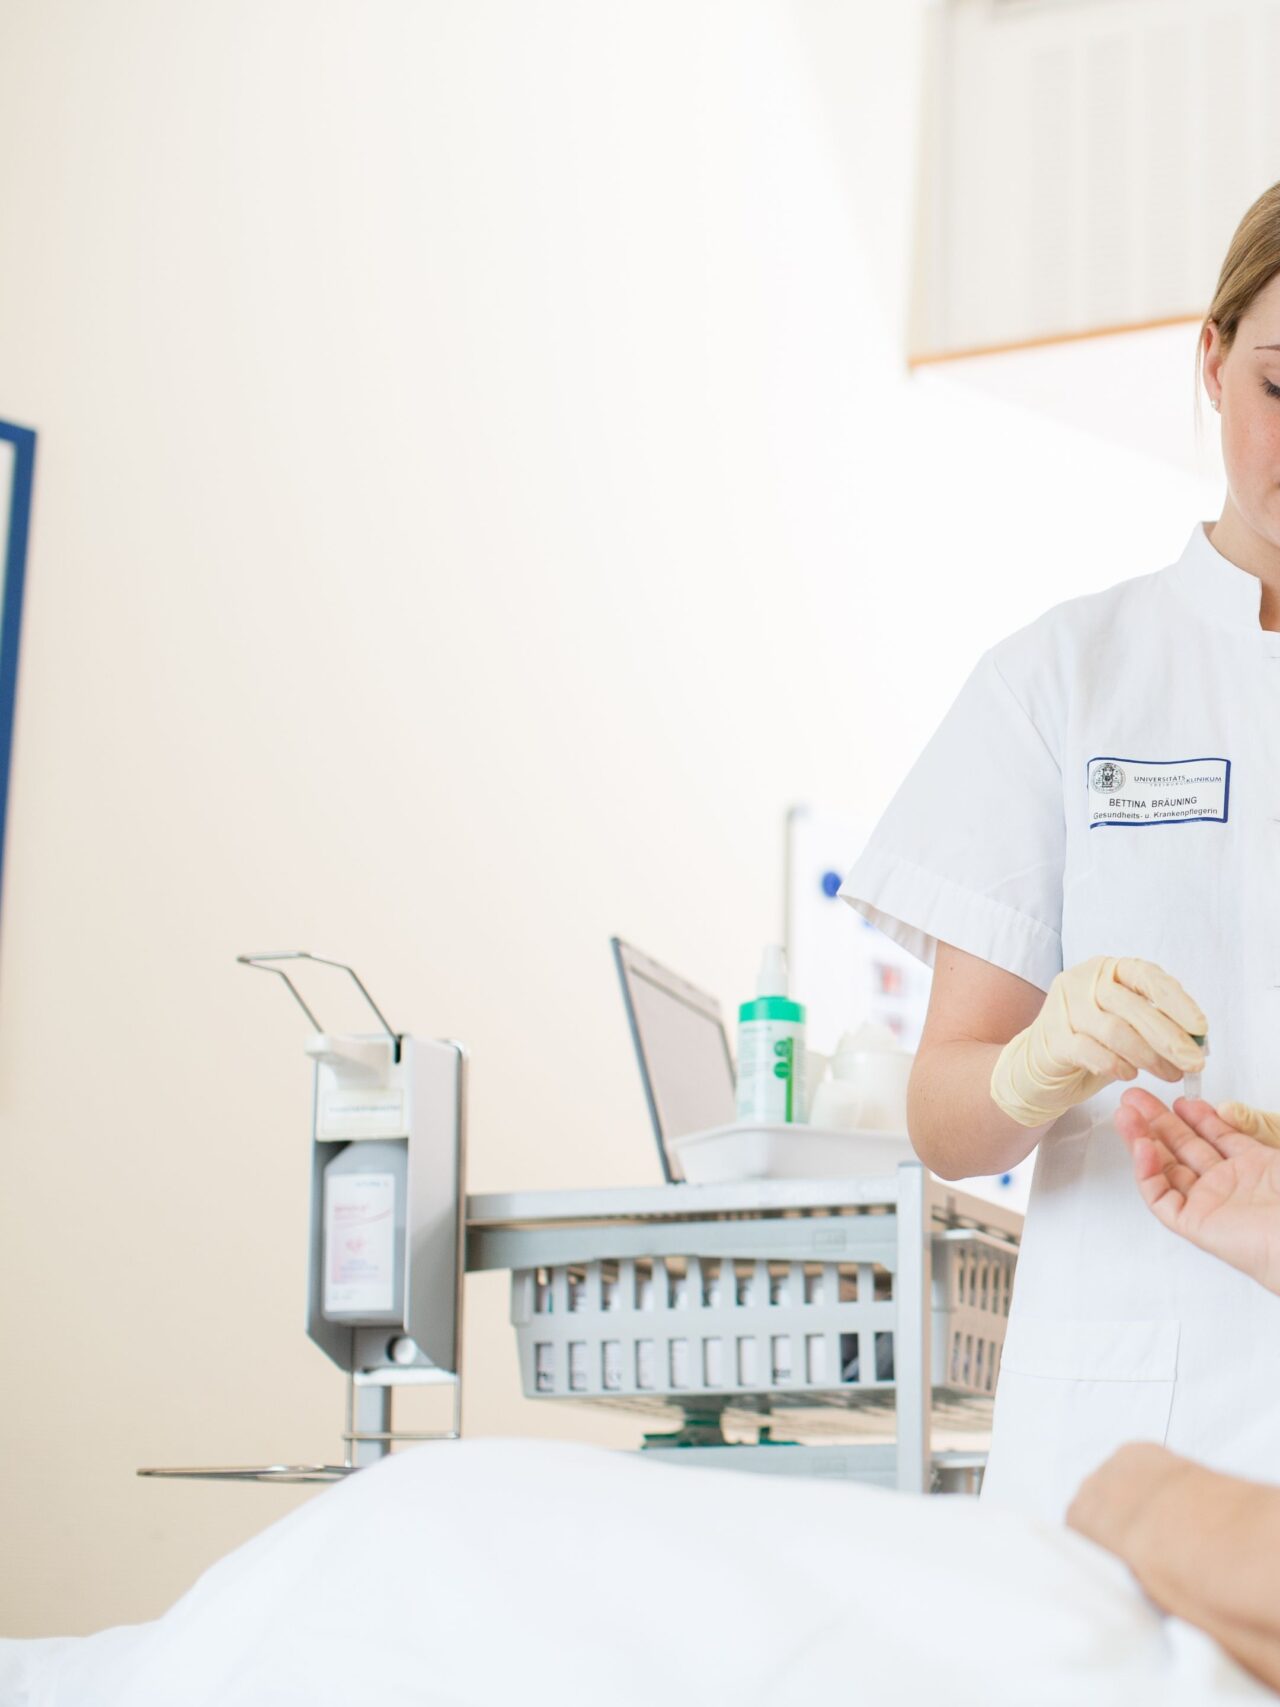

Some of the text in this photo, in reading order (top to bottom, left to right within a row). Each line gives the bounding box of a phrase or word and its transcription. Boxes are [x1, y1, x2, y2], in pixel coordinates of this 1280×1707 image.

[1109, 796, 1198, 809] BETTINA BRÄUNING
[1153, 809, 1218, 819] Krankenpflegerin
